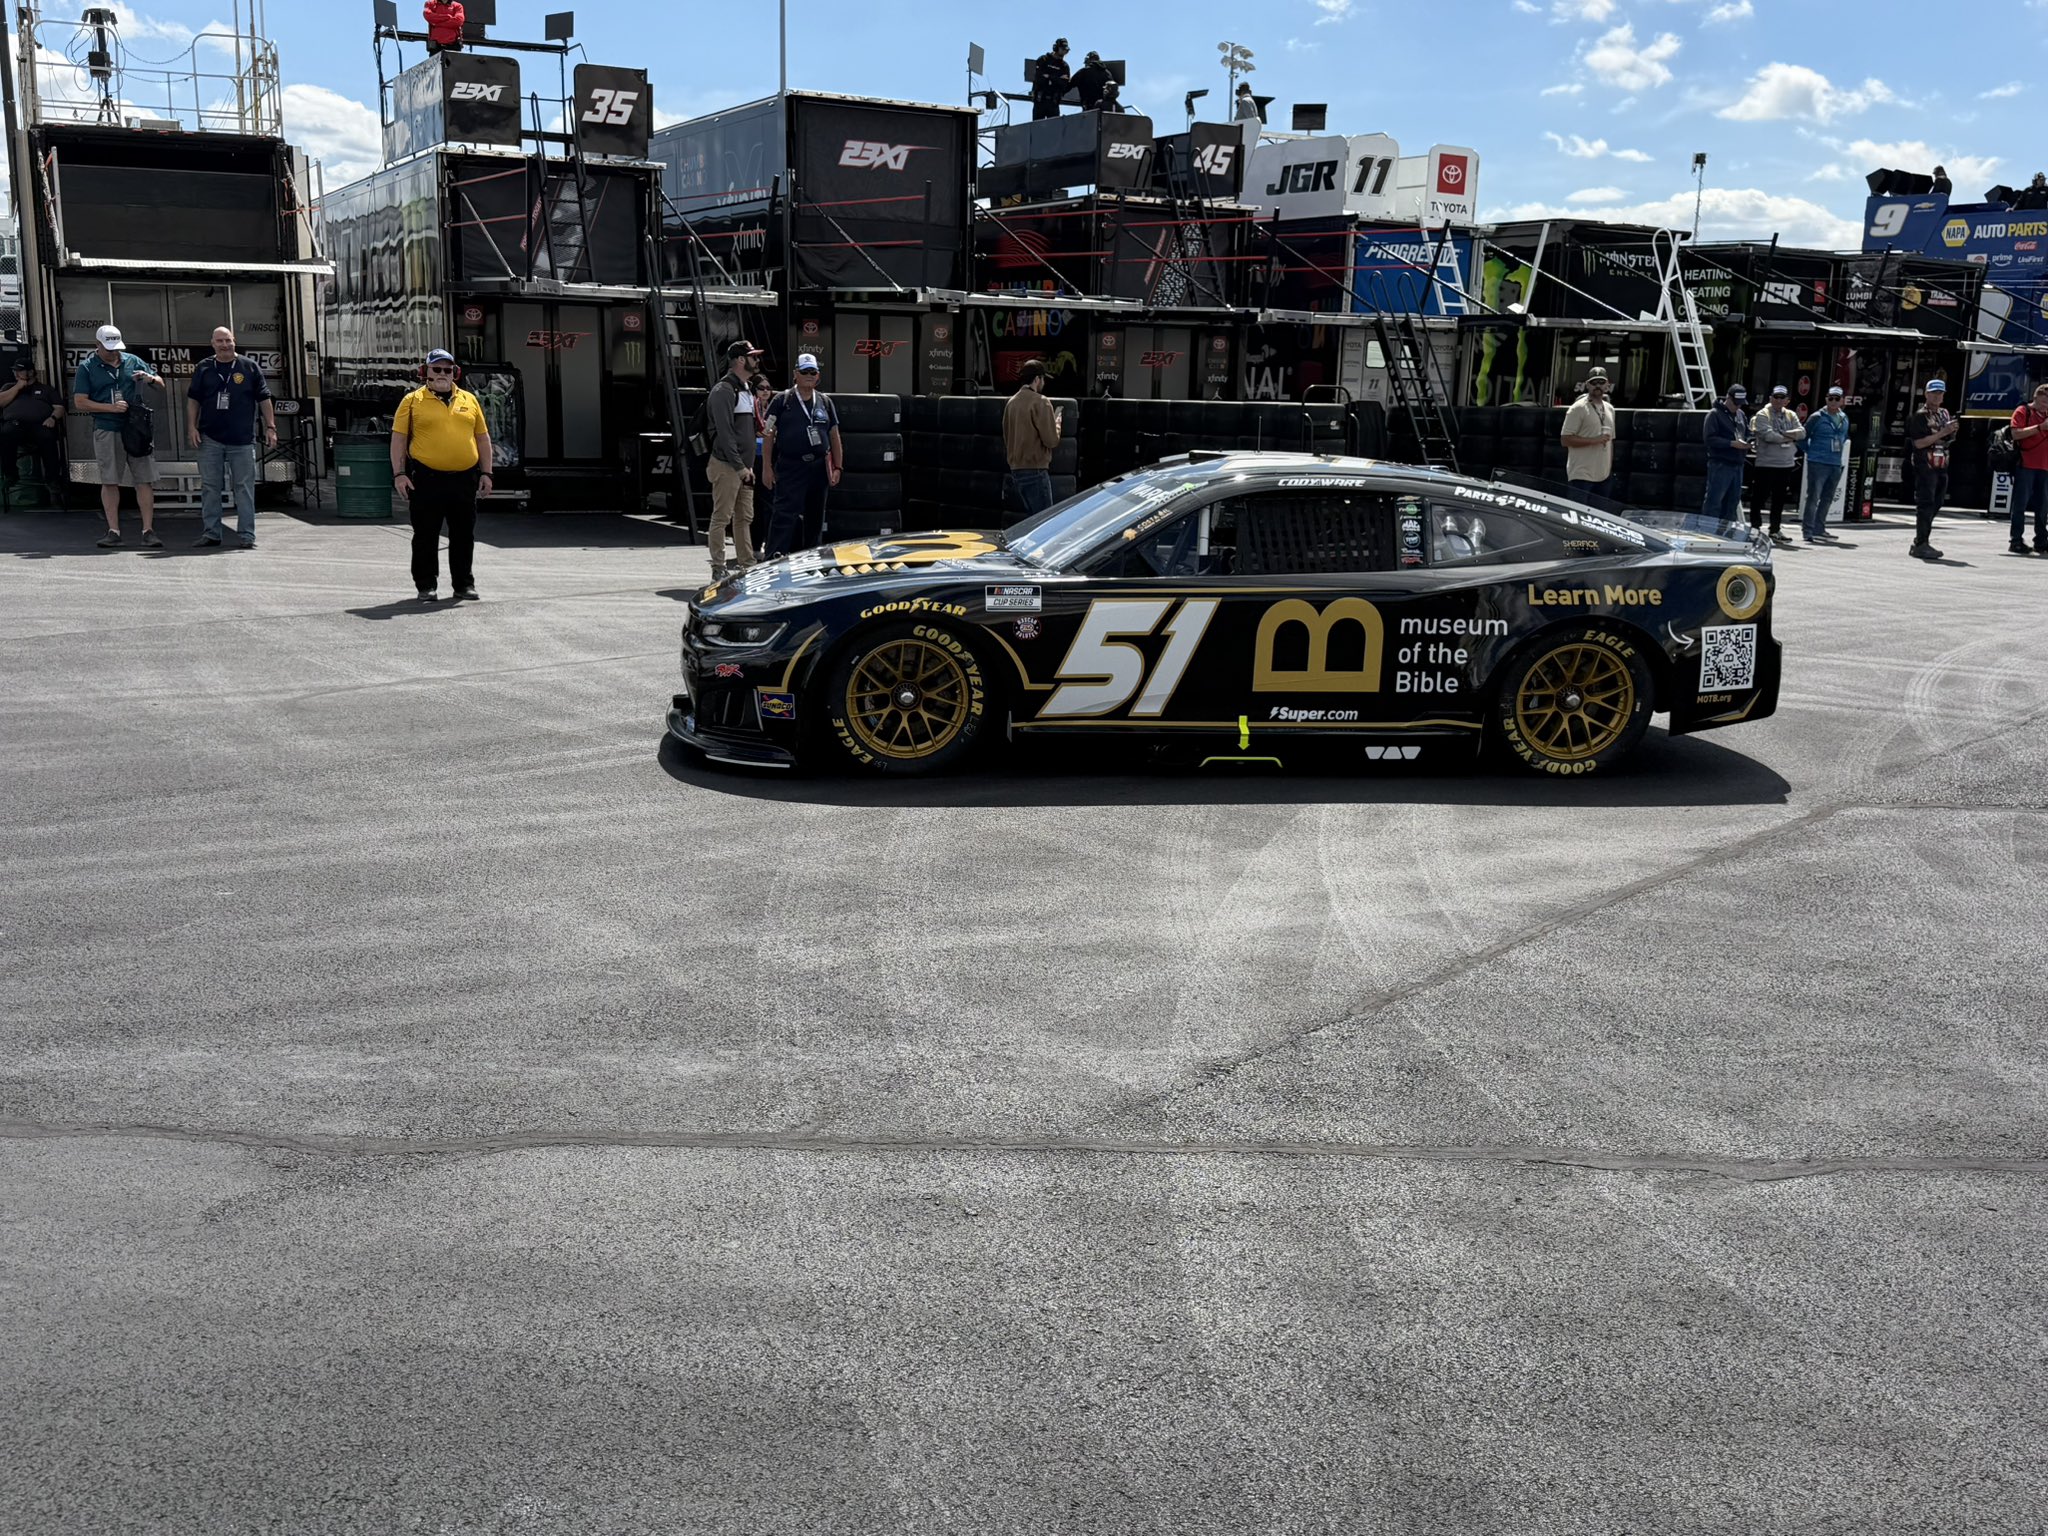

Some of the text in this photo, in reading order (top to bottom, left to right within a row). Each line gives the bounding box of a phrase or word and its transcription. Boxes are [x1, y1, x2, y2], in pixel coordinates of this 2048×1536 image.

[581, 88, 639, 126] 35
[838, 140, 935, 171] 23XI
[1193, 144, 1235, 176] 45
[1266, 160, 1339, 196] JGR
[1352, 155, 1395, 196] 11
[1869, 203, 1911, 238] 9
[1945, 221, 2048, 240] NAPA AUTO PARTS
[1992, 253, 2013, 263] prime
[1684, 268, 1733, 281] HEATING
[149, 348, 191, 361] TEAM
[1320, 478, 1366, 487] WARE
[1454, 486, 1549, 514] PARTS PLUS
[1580, 515, 1645, 541] JACOB
[1580, 521, 1646, 547] CONSTRUCTION
[993, 598, 1035, 606] CUP SERIES
[1003, 587, 1034, 596] NASCAR
[1528, 584, 1663, 606] Learn More
[860, 597, 968, 619] GOODYEAR
[1400, 617, 1509, 637] museum
[1398, 642, 1469, 665] of the
[1583, 629, 1636, 658] EAGLE
[1034, 597, 1224, 719] 51
[912, 624, 985, 717] GOODYEAR
[1395, 671, 1459, 694] Bible
[1697, 694, 1732, 705] MOTB.org
[1277, 706, 1358, 722] Super.com
[832, 717, 875, 765] EAGLE
[1503, 716, 1598, 775] GOODYEAR
